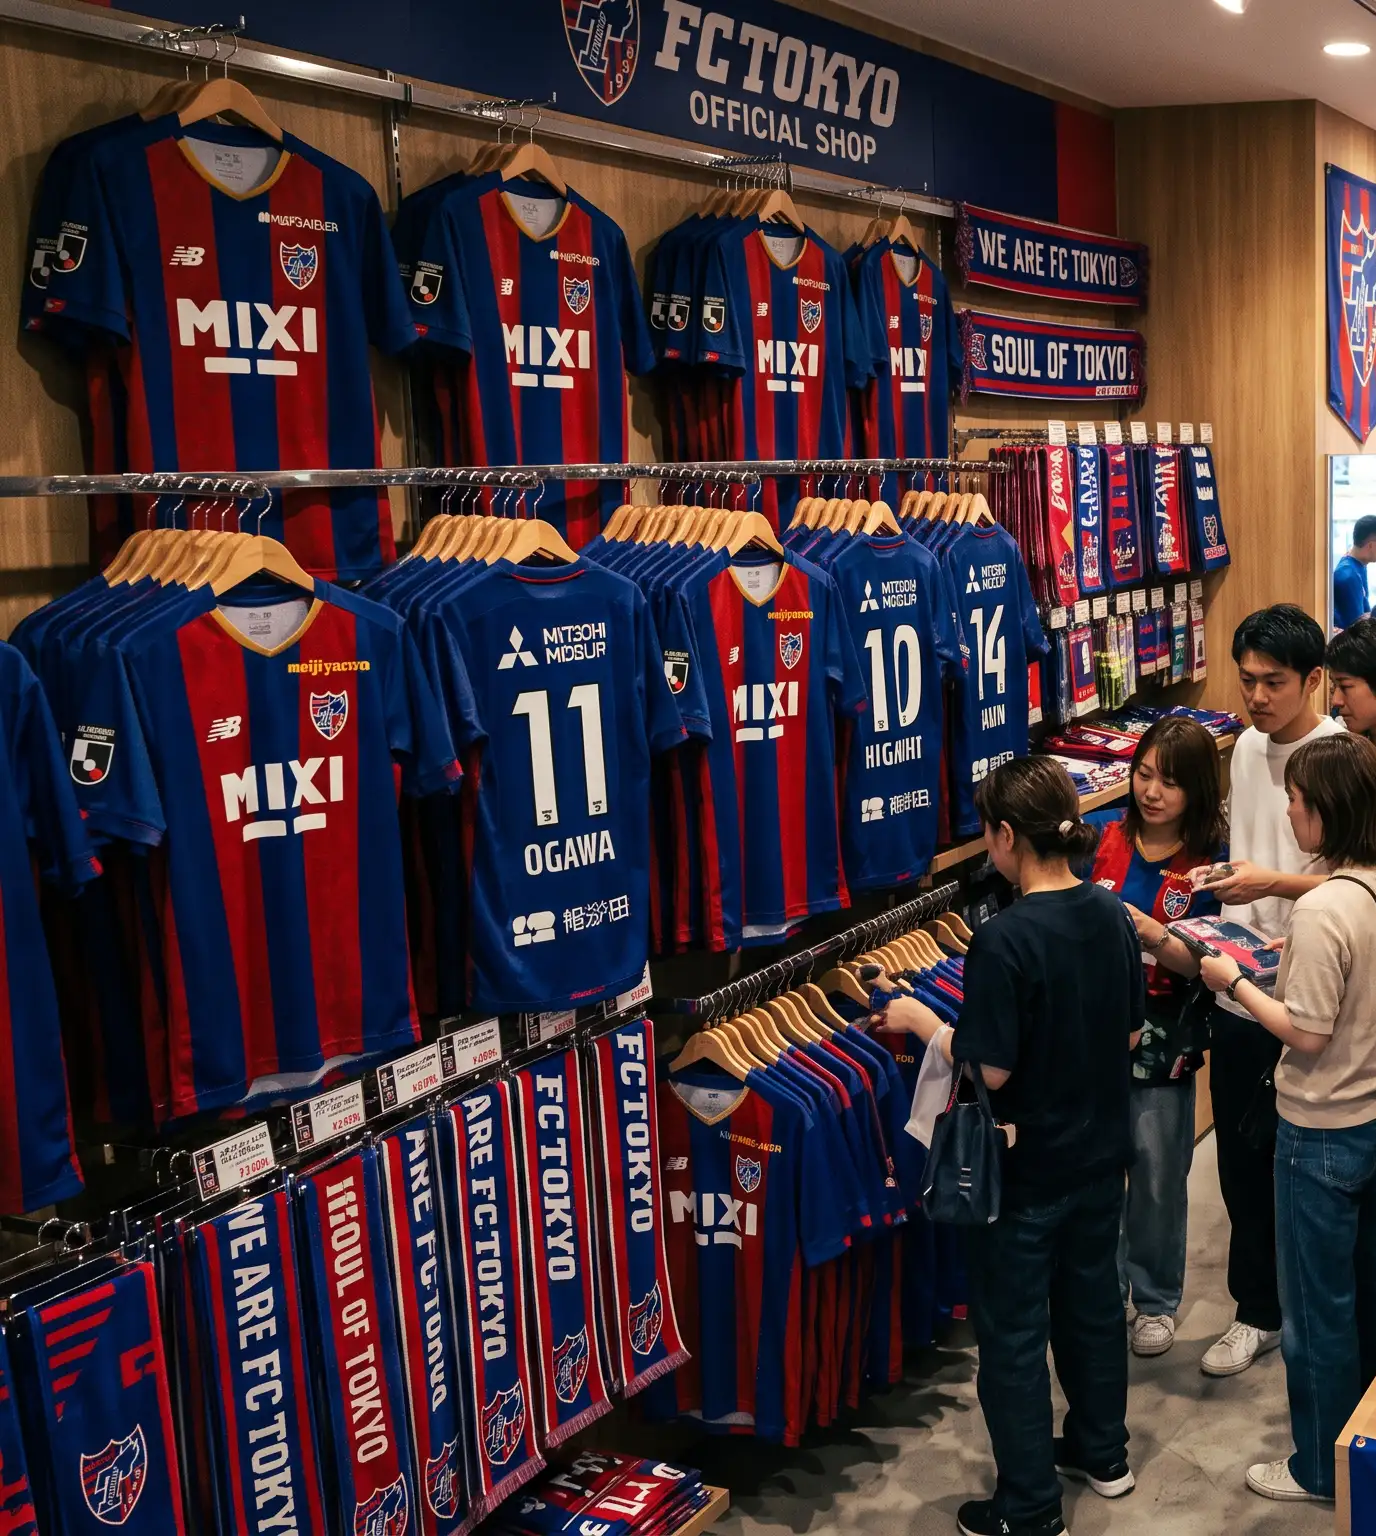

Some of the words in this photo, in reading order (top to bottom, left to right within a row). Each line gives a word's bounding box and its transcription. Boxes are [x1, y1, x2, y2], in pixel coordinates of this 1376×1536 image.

[689, 90, 809, 149] OFFICIAL
[815, 122, 877, 164] SHOP
[977, 227, 1008, 270] WE
[1013, 237, 1045, 277] ARE
[1049, 245, 1068, 281] FC
[1071, 249, 1118, 287] TOKYO
[176, 298, 318, 353] MIXI
[501, 323, 591, 369] MIXI
[757, 339, 819, 377] MIXI
[991, 333, 1041, 378] SOUL
[1047, 341, 1070, 380] OF
[1073, 343, 1127, 381] TOKYO
[864, 624, 922, 733] 10
[970, 604, 1006, 701] 14
[733, 681, 799, 724] MIXI
[511, 683, 608, 827] 11
[220, 755, 345, 823] MIXI
[524, 829, 616, 877] OGAWA
[616, 1032, 647, 1087] FC
[462, 1094, 492, 1171] ARE
[535, 1074, 565, 1130] FC
[623, 1091, 654, 1233] TOKYO
[540, 1137, 576, 1281] TOKYO
[669, 1190, 758, 1236] MIXI
[233, 1262, 278, 1350] ARE
[341, 1297, 371, 1338] OF
[474, 1235, 508, 1362] TOKYO
[241, 1348, 284, 1412] FC
[345, 1343, 389, 1464] TOKYO
[247, 1410, 300, 1536] TOKY
